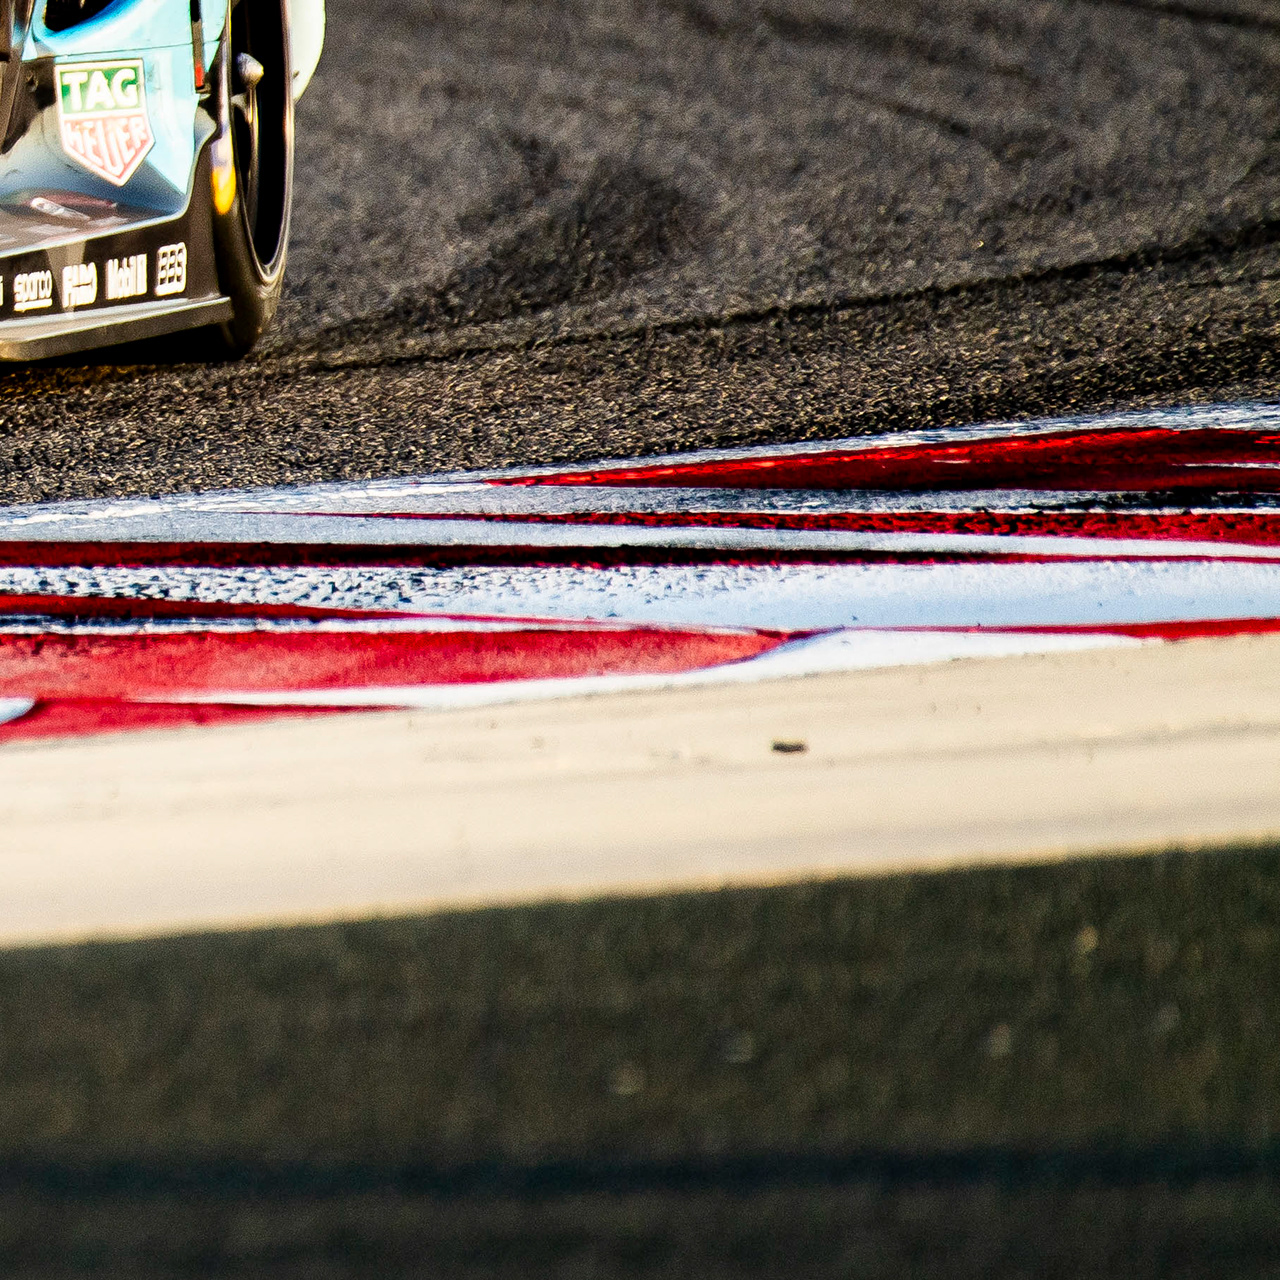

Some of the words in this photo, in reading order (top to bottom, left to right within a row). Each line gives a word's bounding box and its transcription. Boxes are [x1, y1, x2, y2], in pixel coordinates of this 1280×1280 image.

[62, 68, 139, 112] TAG
[64, 116, 148, 171] HEUER
[13, 269, 52, 303] sparco
